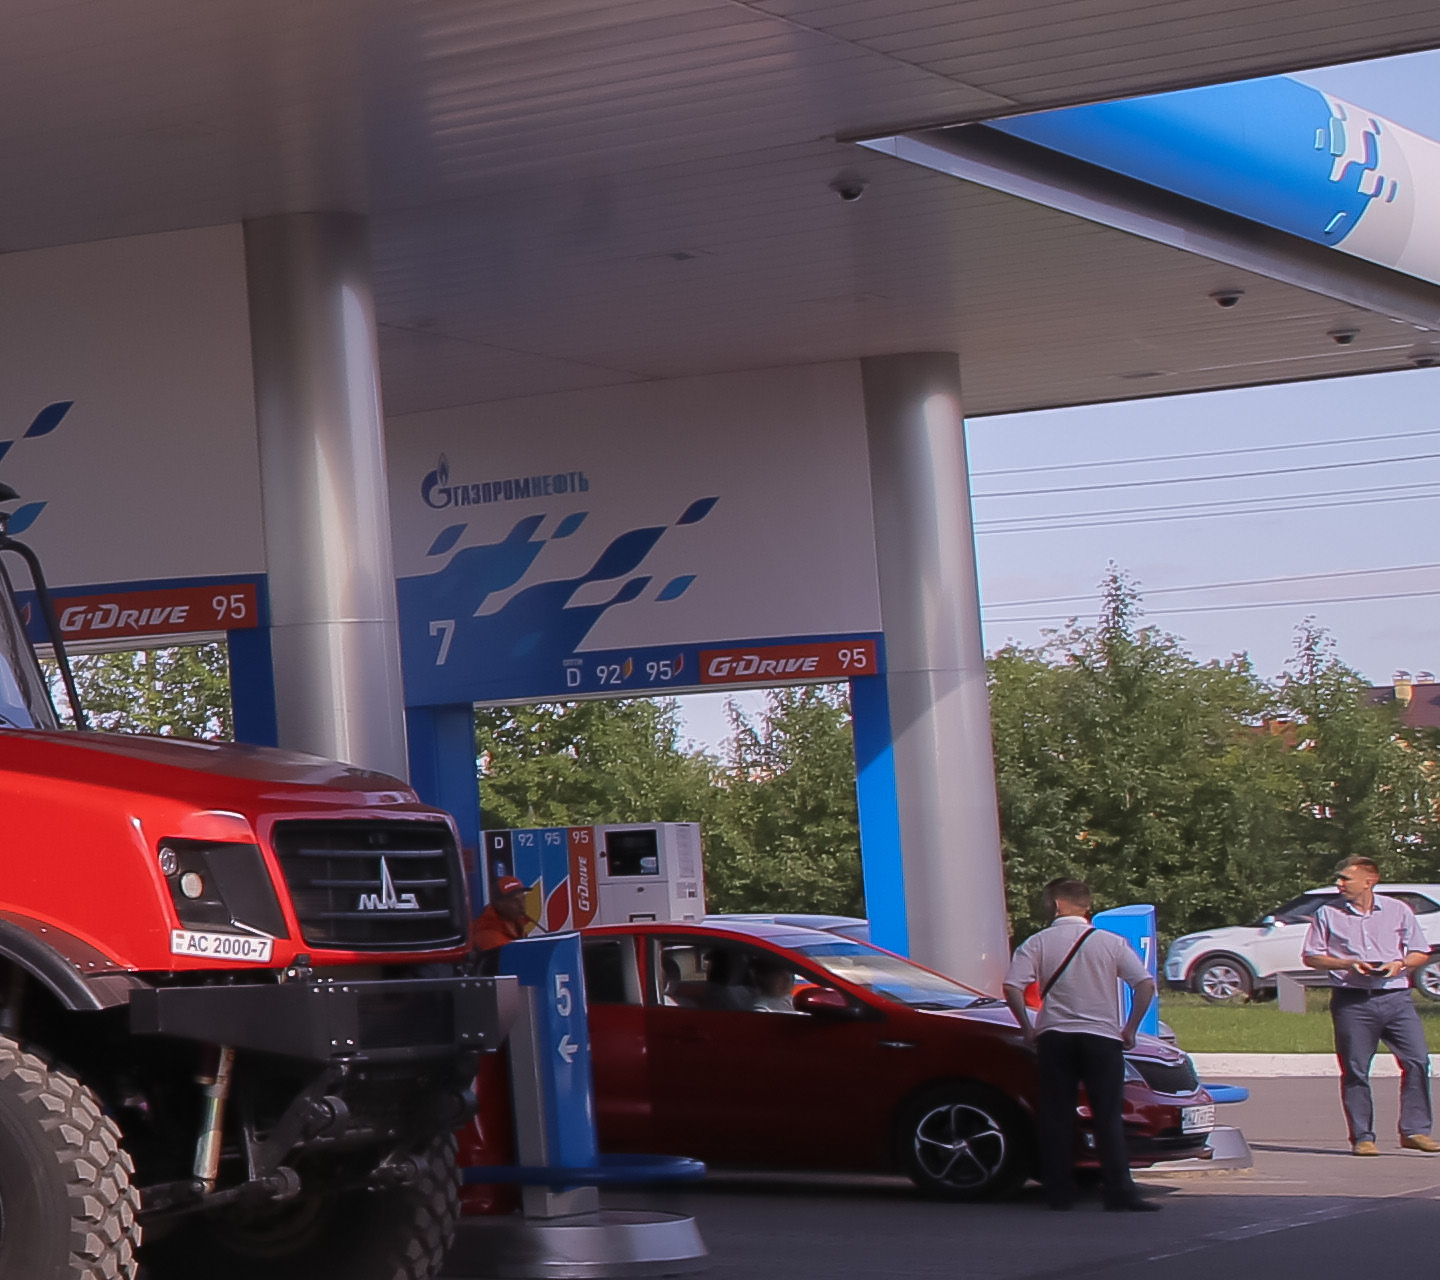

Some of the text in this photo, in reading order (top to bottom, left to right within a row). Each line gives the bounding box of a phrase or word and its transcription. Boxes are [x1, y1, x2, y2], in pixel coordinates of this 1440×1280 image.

[453, 471, 590, 508] ГАЗПРОМНЕФТЬ
[211, 593, 247, 621] 95
[429, 619, 456, 666] 7
[567, 669, 580, 687] D
[596, 665, 622, 686] 92
[646, 660, 672, 681] 95
[838, 648, 867, 669] 95
[494, 830, 589, 849] D 92 95 95
[187, 934, 268, 958] AC 2000-7
[1141, 937, 1152, 969] 7
[555, 974, 572, 1016] 5
